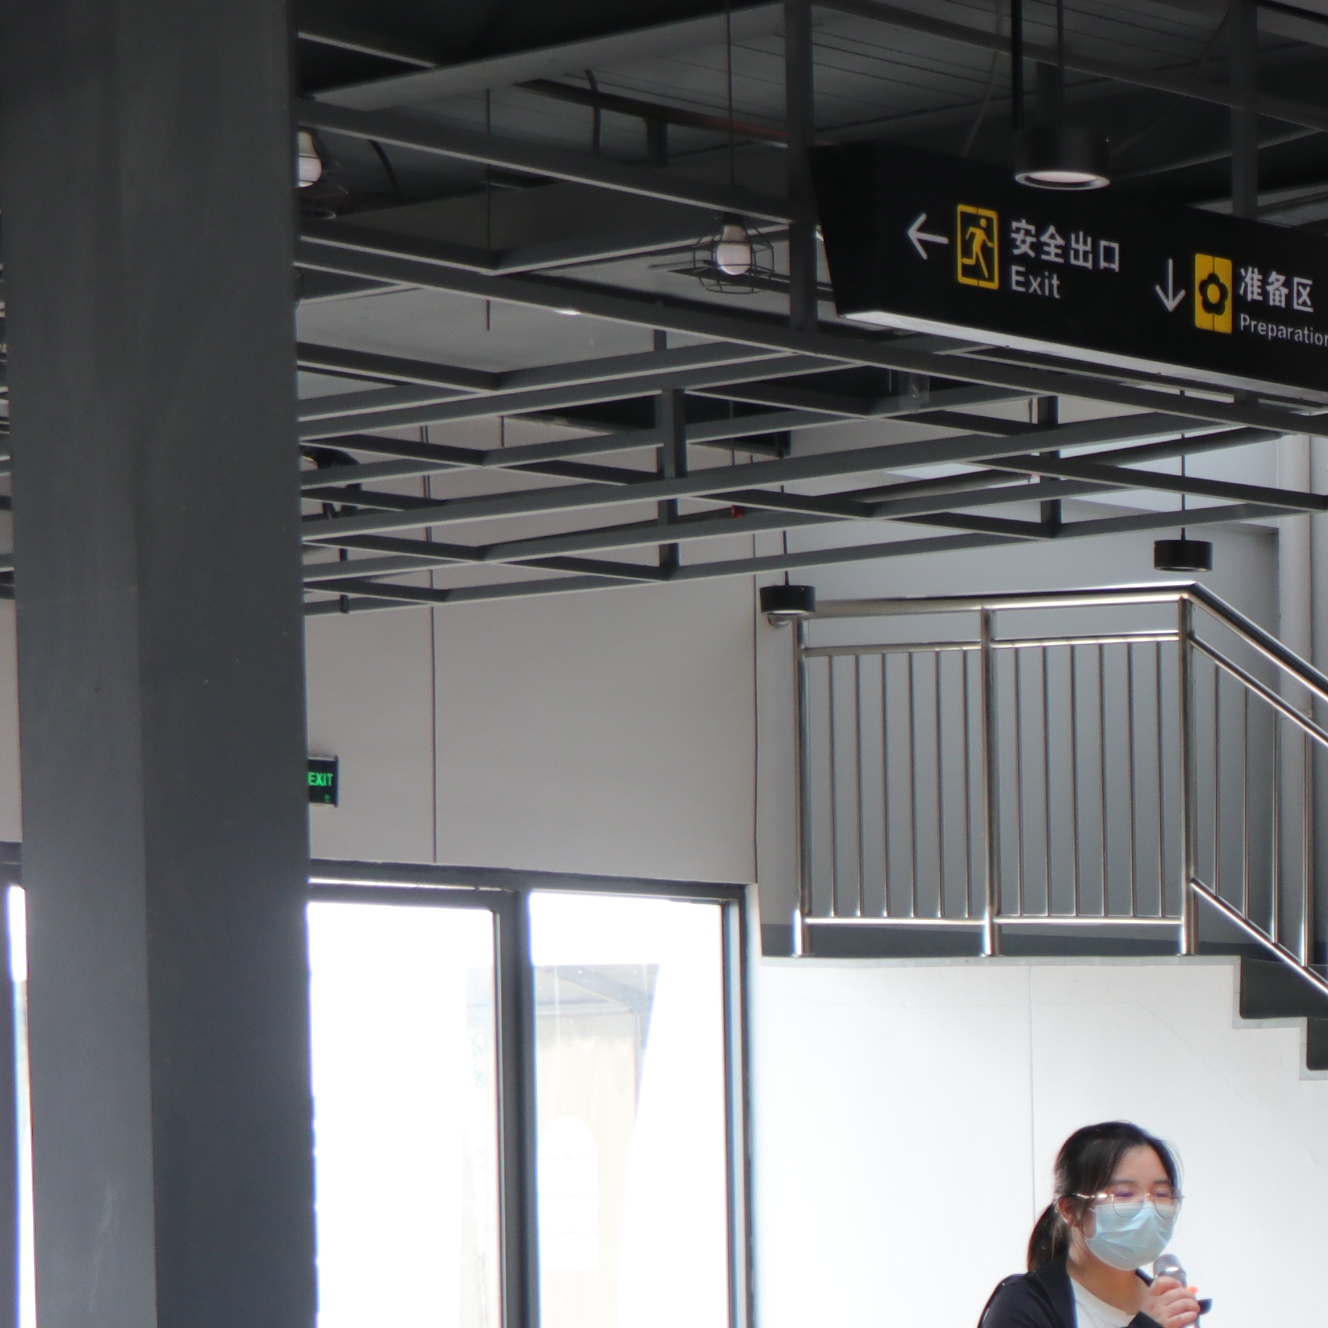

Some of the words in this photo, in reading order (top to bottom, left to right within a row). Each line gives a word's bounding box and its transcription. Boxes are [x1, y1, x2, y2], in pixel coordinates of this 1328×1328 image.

[1010, 218, 1120, 273] 安全出口
[1011, 264, 1061, 299] Exit
[1239, 266, 1314, 313] 准备区
[307, 771, 334, 787] EXIT
